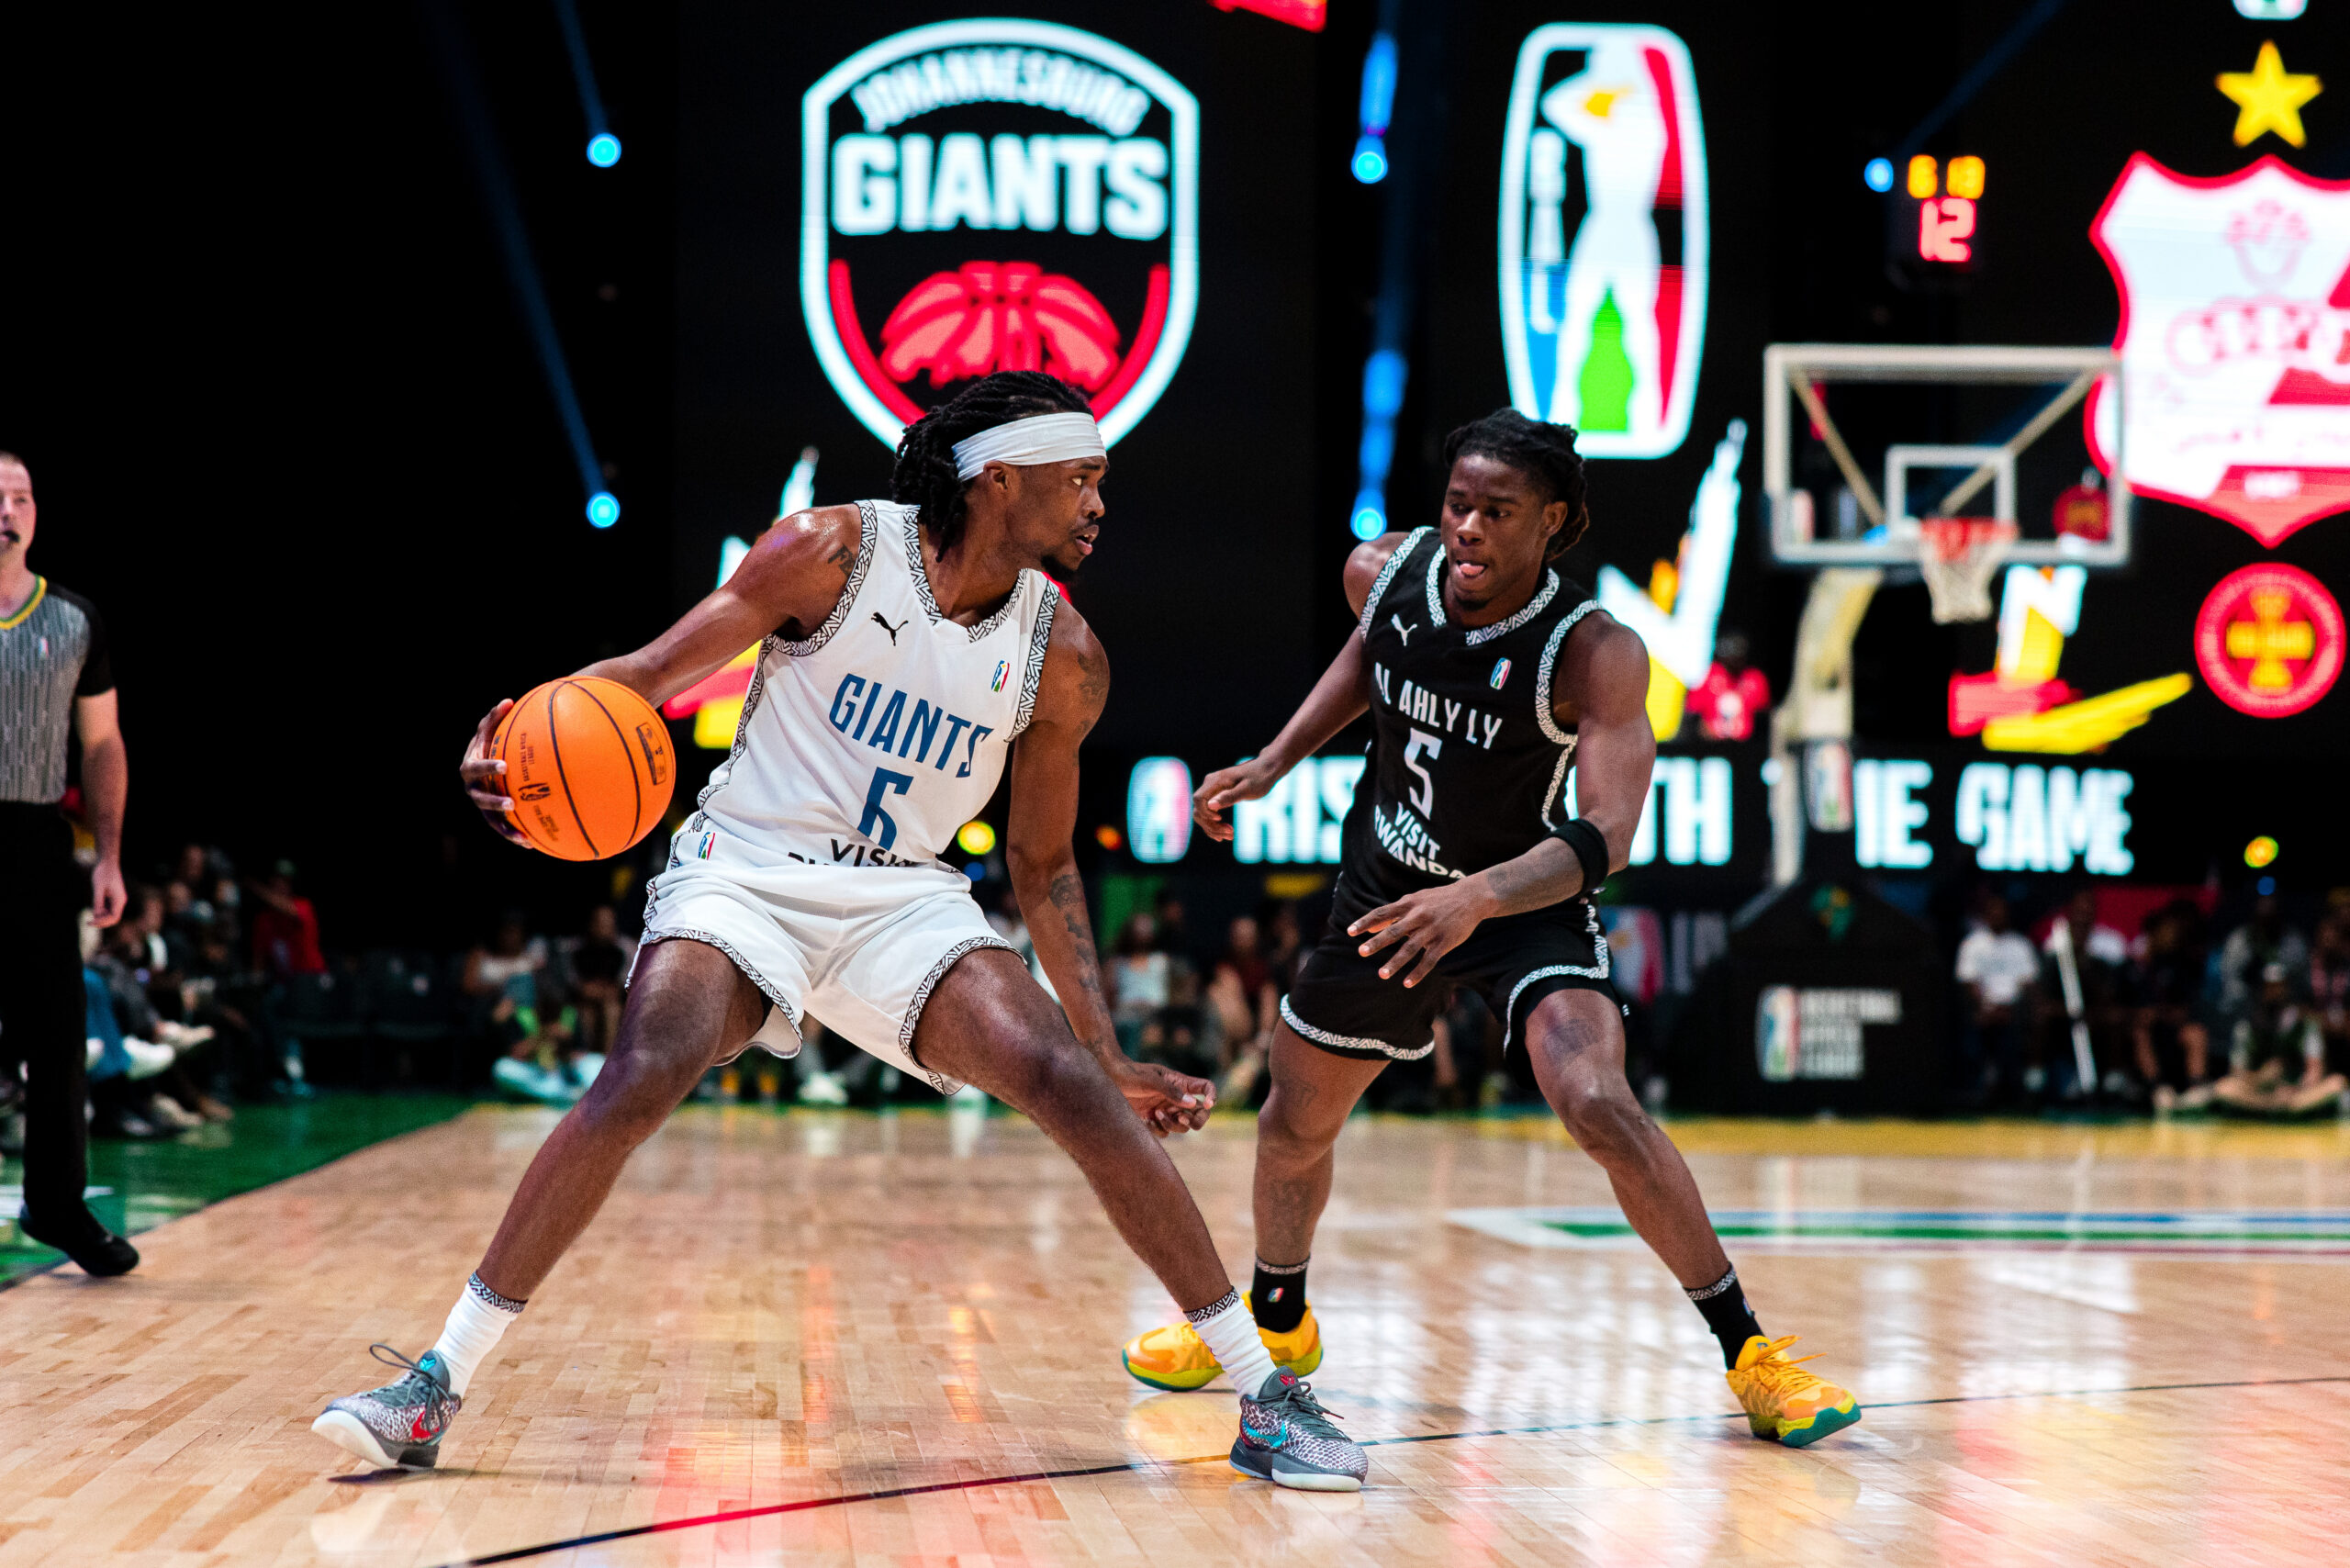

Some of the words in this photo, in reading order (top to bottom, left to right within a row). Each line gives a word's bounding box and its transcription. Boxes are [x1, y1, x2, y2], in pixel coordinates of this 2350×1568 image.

[833, 132, 1169, 241] GIANTS
[1918, 196, 1976, 263] 12
[829, 673, 994, 778] GIANTS
[1398, 679, 1461, 733] AHLY
[1466, 708, 1503, 750] LY
[1233, 756, 1367, 864] RIS
[1956, 761, 2134, 876] GAME
[1404, 727, 1442, 821] 5
[1394, 801, 1440, 861] VISIT
